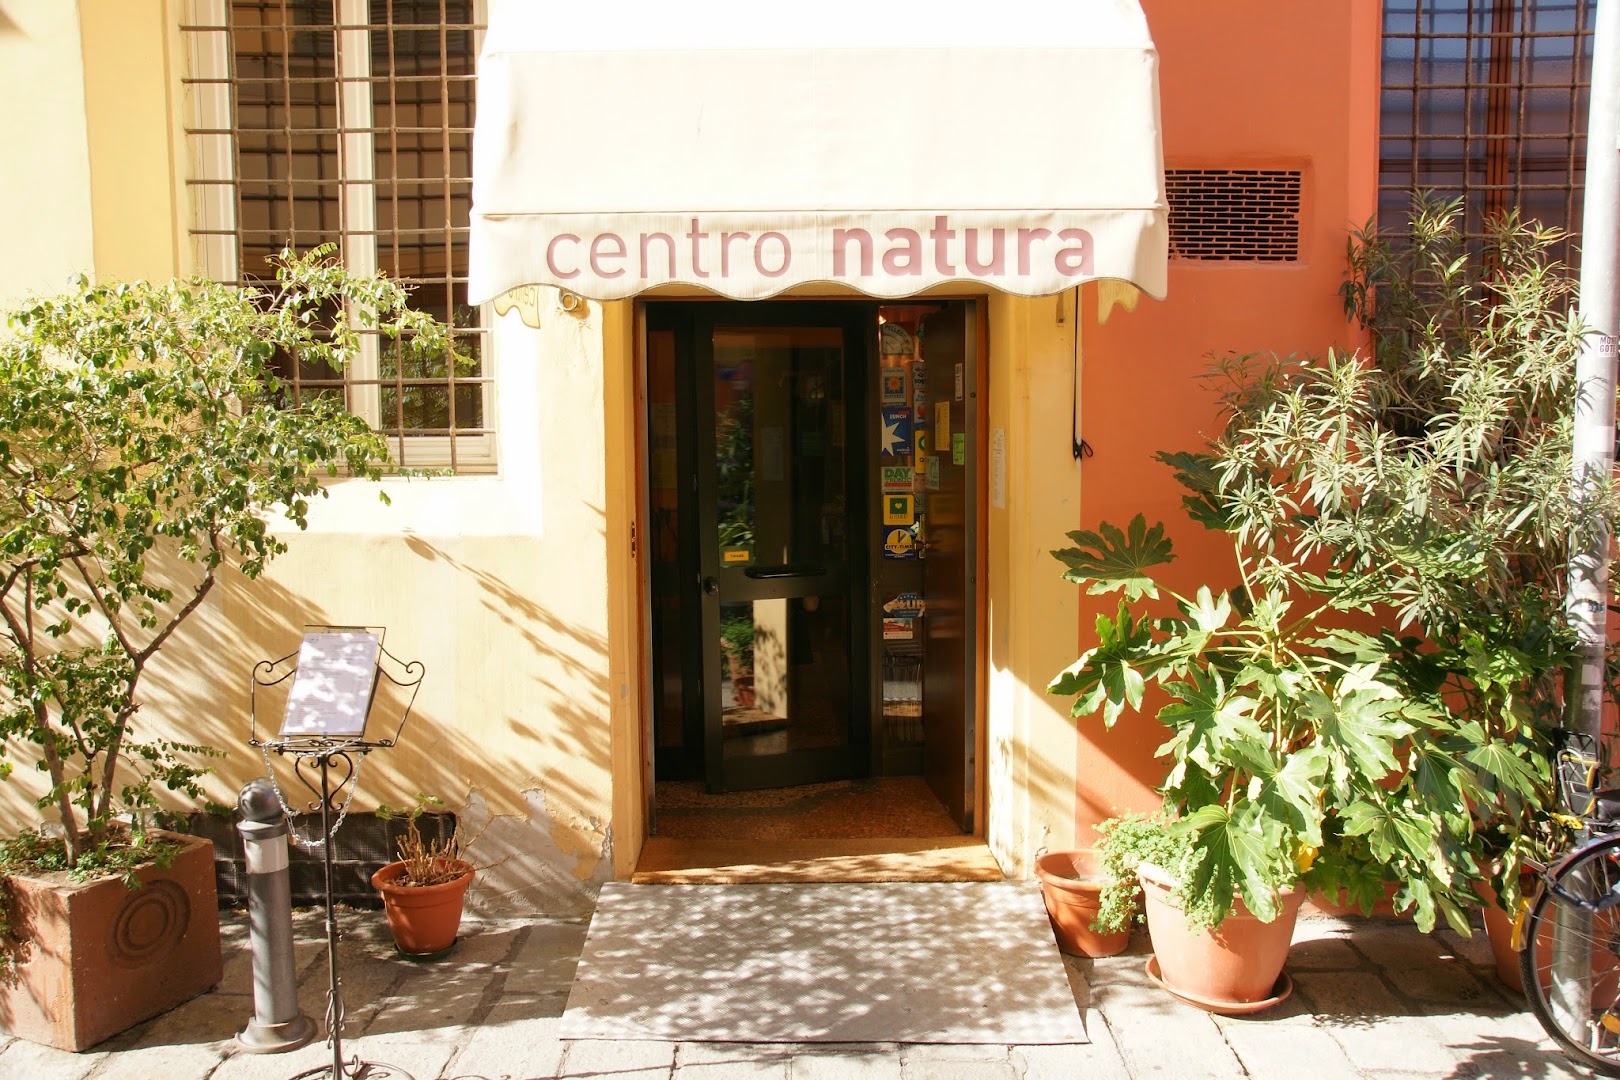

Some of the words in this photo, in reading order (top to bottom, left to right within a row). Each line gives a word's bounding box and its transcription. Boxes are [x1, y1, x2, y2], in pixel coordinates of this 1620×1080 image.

[547, 218, 792, 279] centro
[833, 215, 1095, 277] natura
[884, 468, 910, 479] DAY
